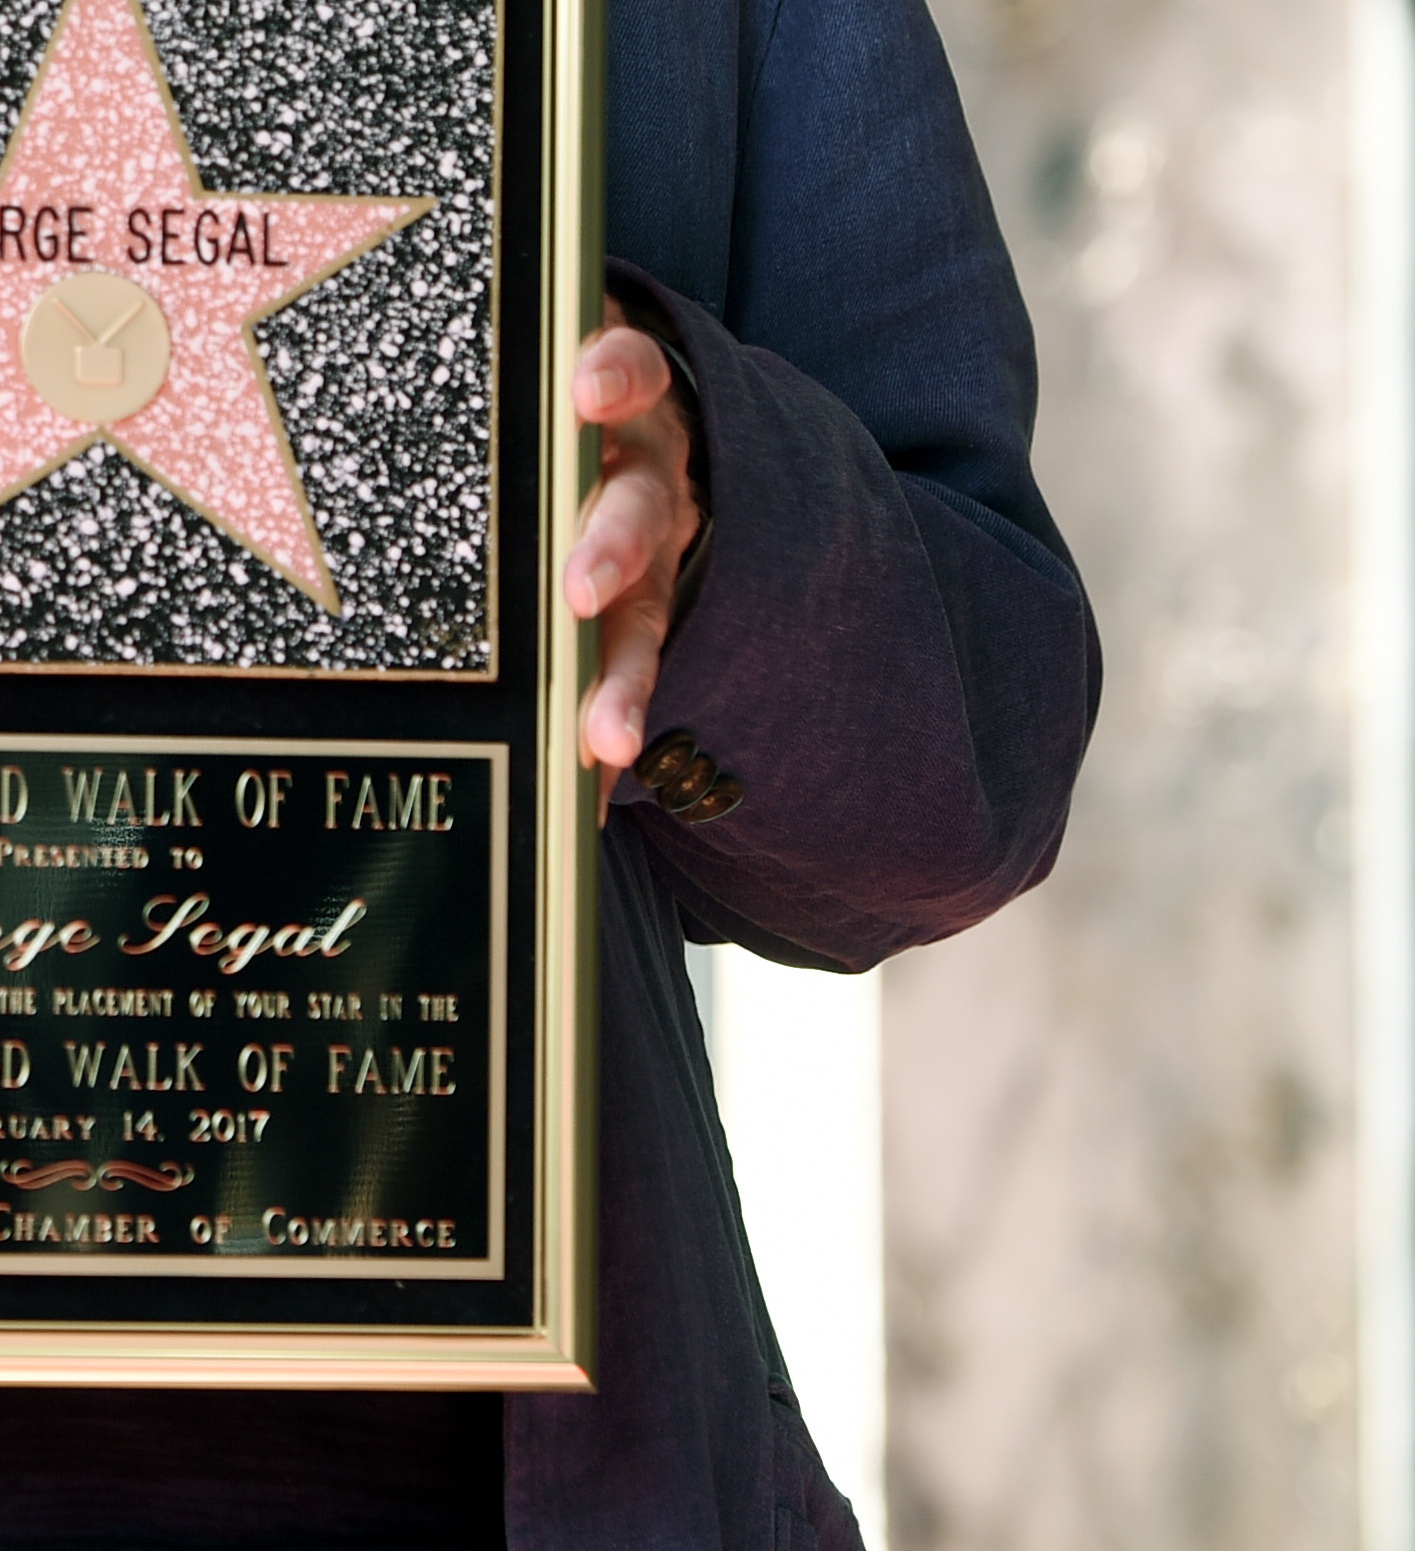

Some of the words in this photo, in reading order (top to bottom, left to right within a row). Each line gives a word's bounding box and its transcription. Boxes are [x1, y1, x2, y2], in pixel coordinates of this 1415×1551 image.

[126, 206, 290, 270] SEGAL
[62, 765, 204, 827] WALK
[234, 768, 293, 827] OF
[324, 771, 456, 831] FAME
[116, 892, 369, 975] Segal
[52, 986, 174, 1016] PLACEMENT
[189, 989, 215, 1018] OF
[233, 990, 292, 1018] YOUR
[307, 992, 363, 1019] STAR
[379, 993, 401, 1019] IN
[418, 993, 459, 1020] THE
[65, 1038, 207, 1091] WALK
[237, 1041, 294, 1091] OF
[326, 1045, 458, 1096] FAME
[188, 1110, 272, 1141] 2017
